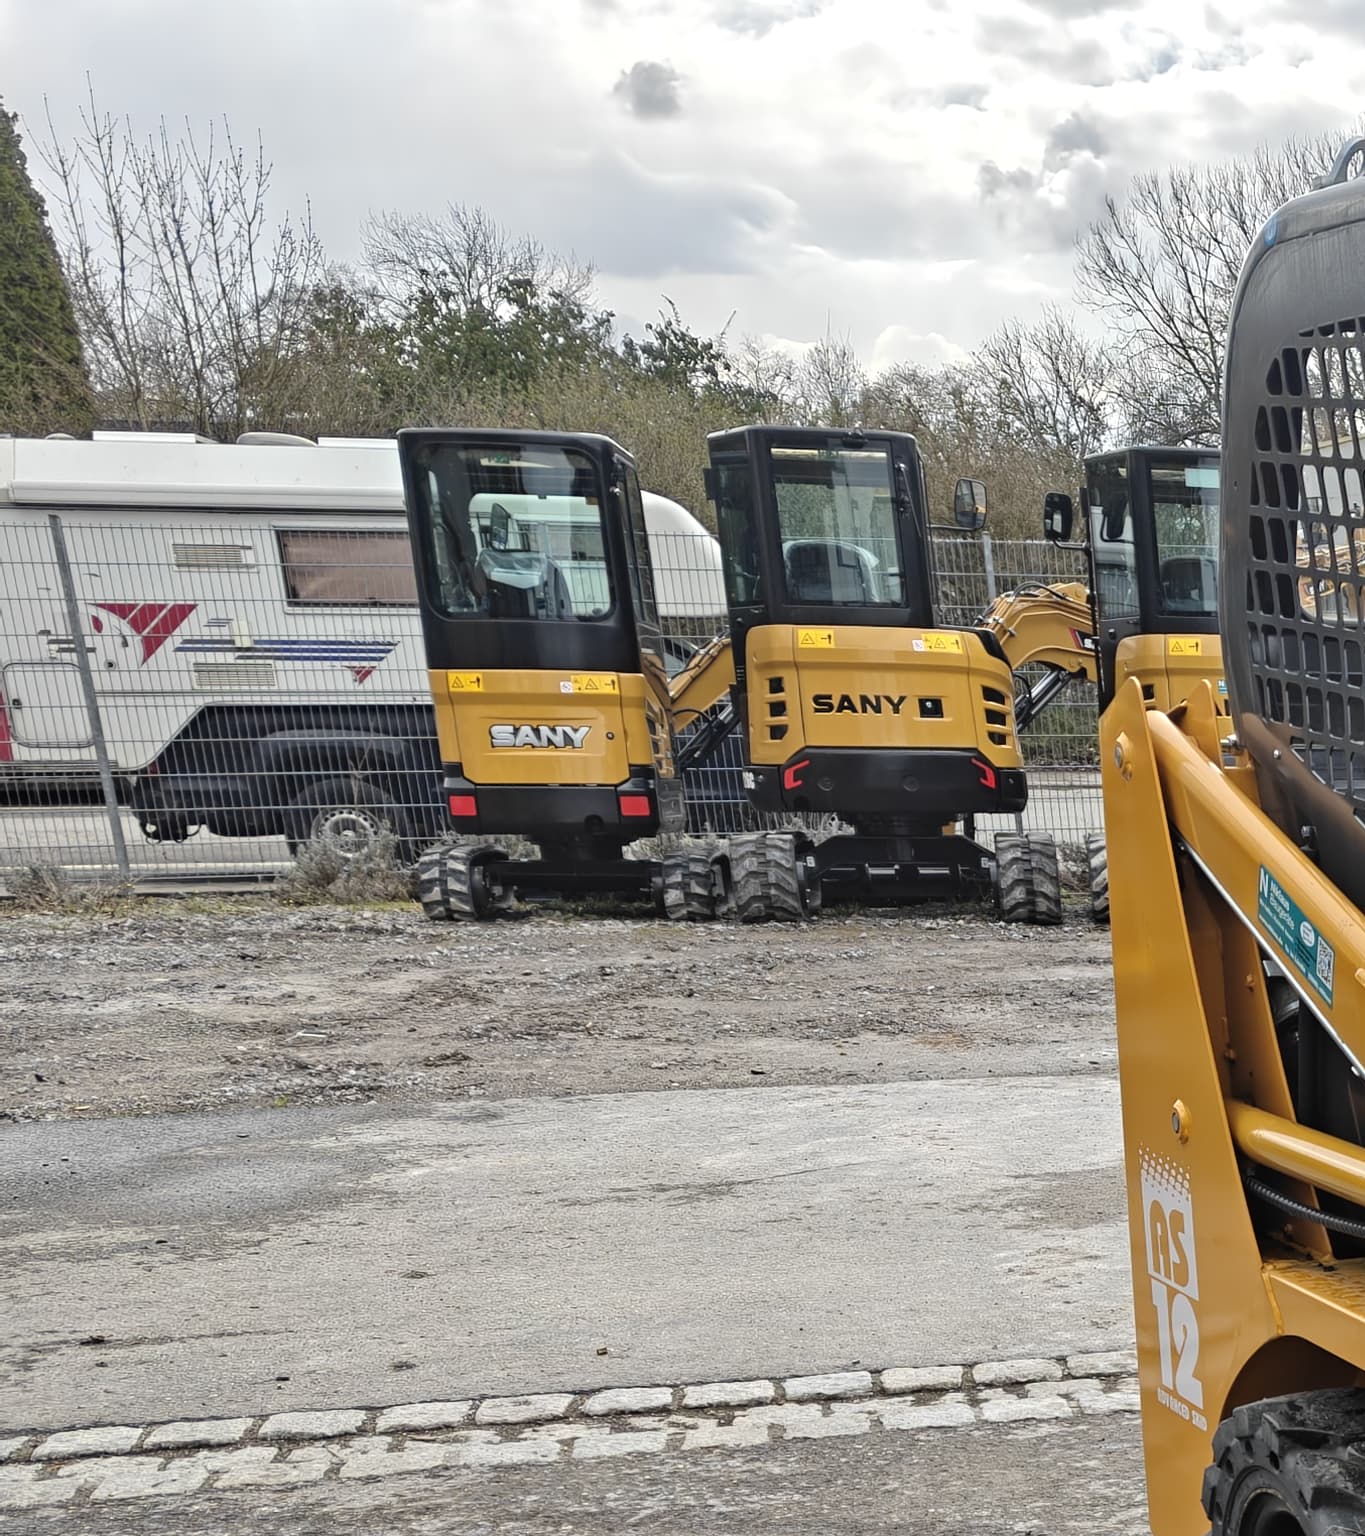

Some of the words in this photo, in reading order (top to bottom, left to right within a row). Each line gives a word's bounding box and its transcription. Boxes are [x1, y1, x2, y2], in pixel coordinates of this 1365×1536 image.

[812, 694, 907, 715] SANY
[489, 724, 592, 749] SANY
[1150, 1199, 1190, 1288] AS
[1151, 1276, 1204, 1410] 12
